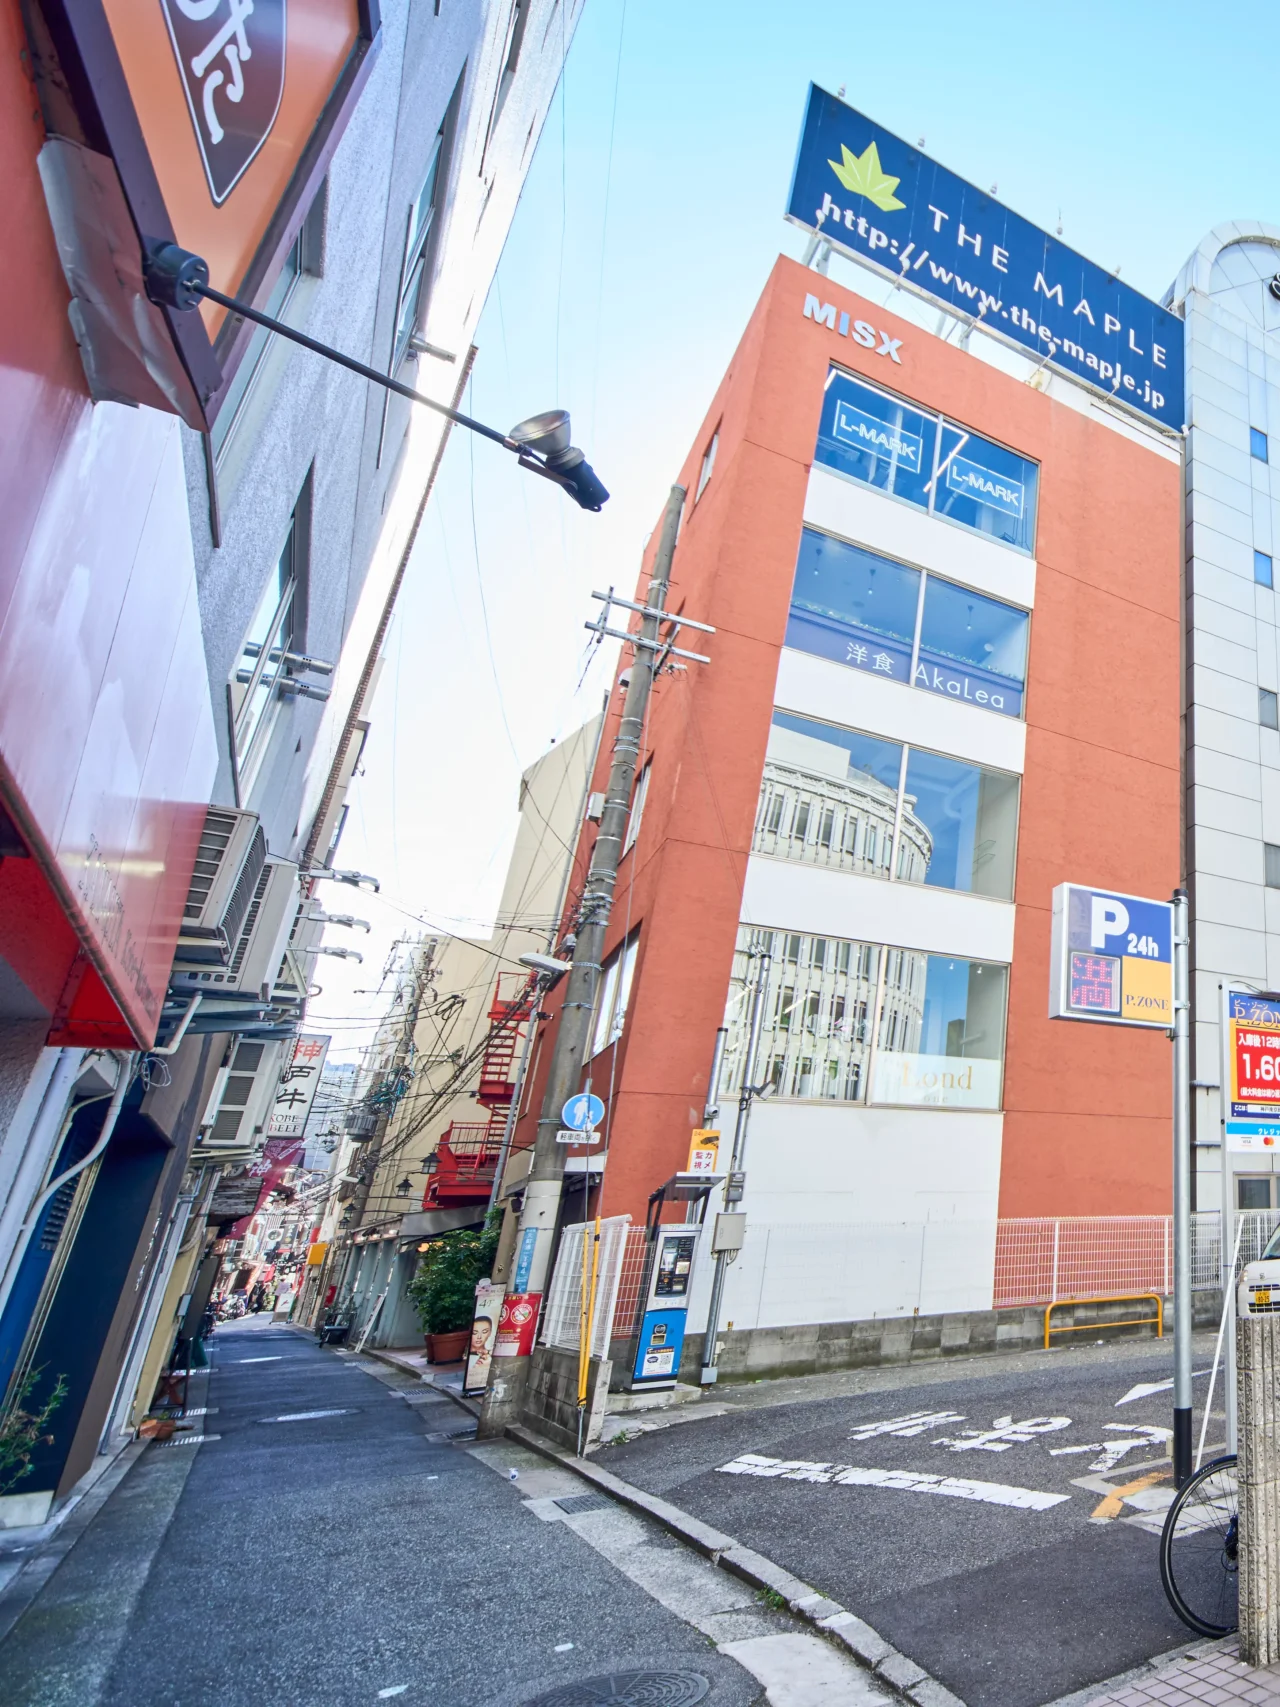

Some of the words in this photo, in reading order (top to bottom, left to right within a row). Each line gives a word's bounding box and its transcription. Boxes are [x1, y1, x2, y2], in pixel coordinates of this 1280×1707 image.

[821, 192, 1167, 410] http://www.the-maple.jp
[928, 204, 1010, 273] THE
[1033, 271, 1168, 369] MAPLE
[802, 292, 904, 365] MISX
[840, 413, 917, 460] L-MARK
[952, 466, 1019, 506] L-MARK
[846, 641, 895, 675] 洋食
[1090, 895, 1130, 949] P
[1127, 932, 1159, 958] 24h
[1125, 993, 1170, 1011] P.ZONE
